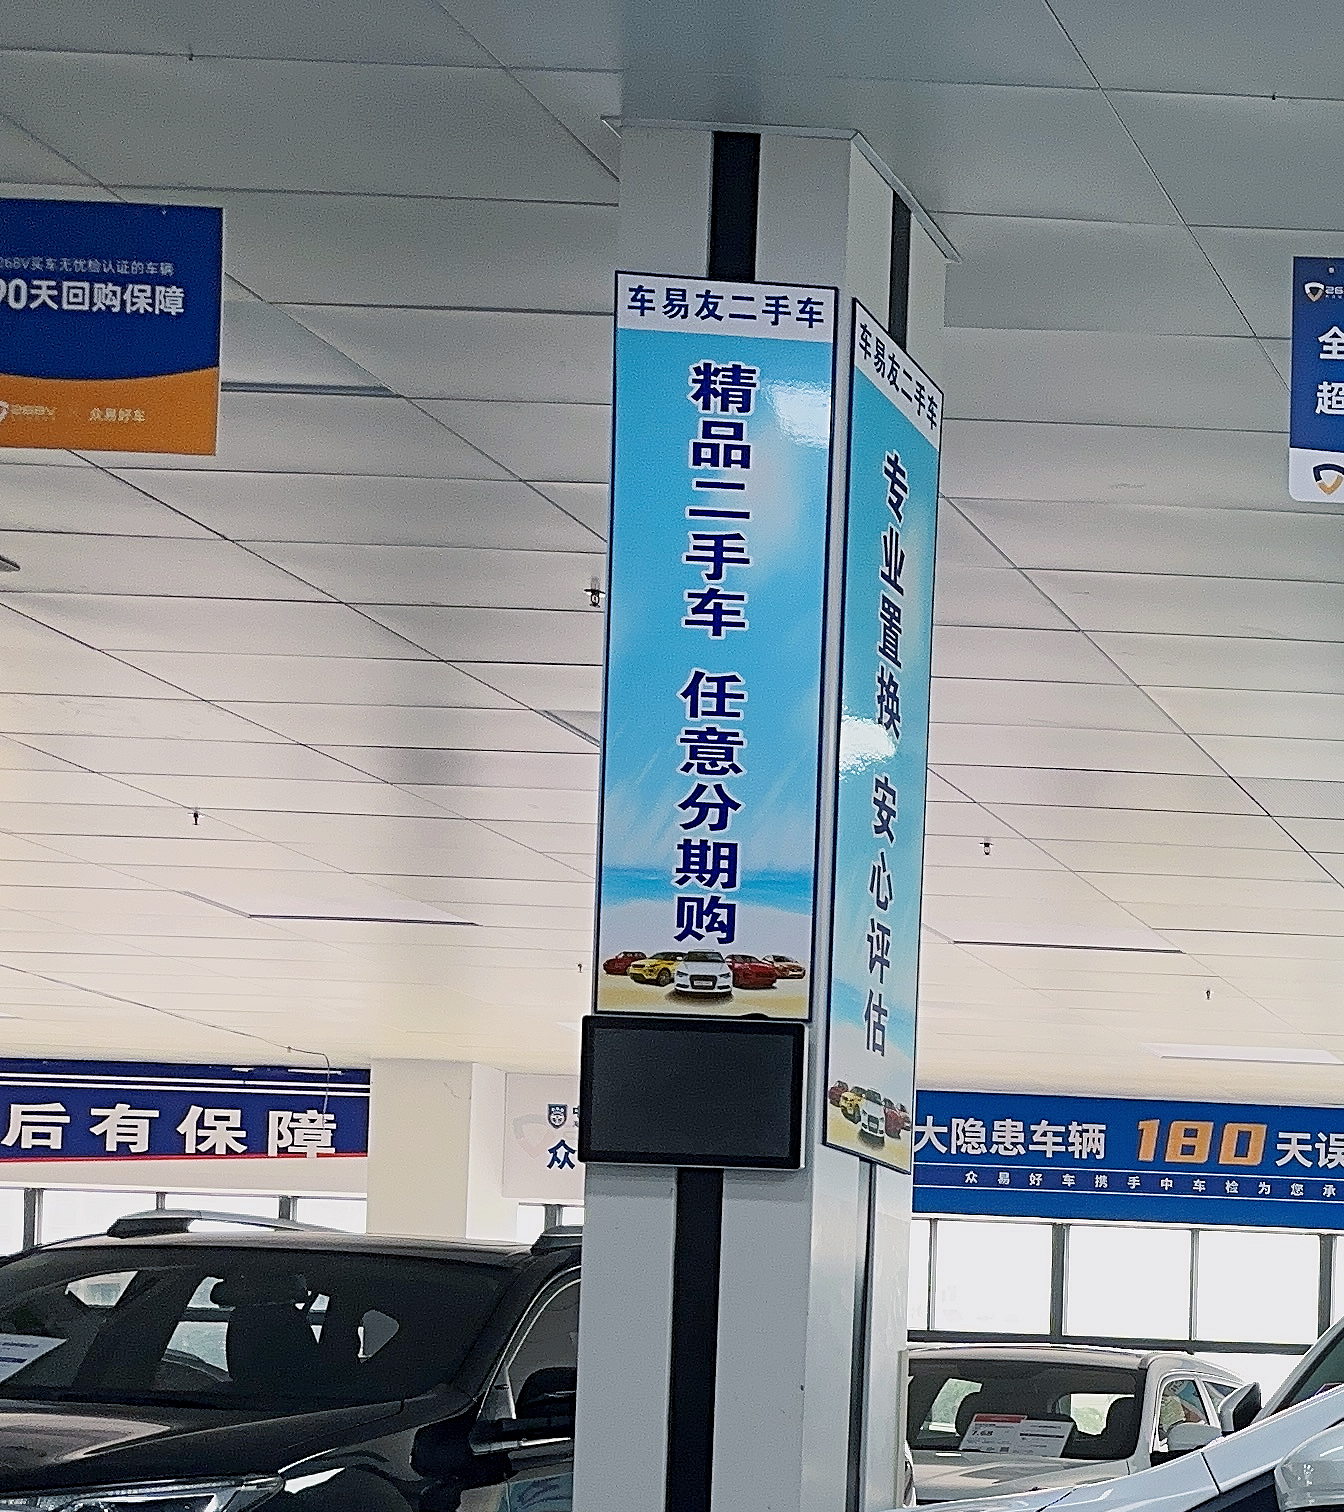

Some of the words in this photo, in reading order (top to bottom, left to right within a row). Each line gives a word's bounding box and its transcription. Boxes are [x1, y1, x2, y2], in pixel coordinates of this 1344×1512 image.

[627, 285, 825, 328] 车易友二手车
[859, 322, 940, 430] 车易友二手车
[684, 361, 757, 637] 精品二手车
[876, 451, 909, 740] 专业置换
[674, 671, 747, 945] 任意分期购
[864, 771, 898, 1057] 安心评估
[1, 1103, 337, 1159] 后有保障
[546, 1139, 578, 1170] 众
[912, 1115, 1107, 1161] 大隐患车辆
[1137, 1118, 1268, 1166] 180
